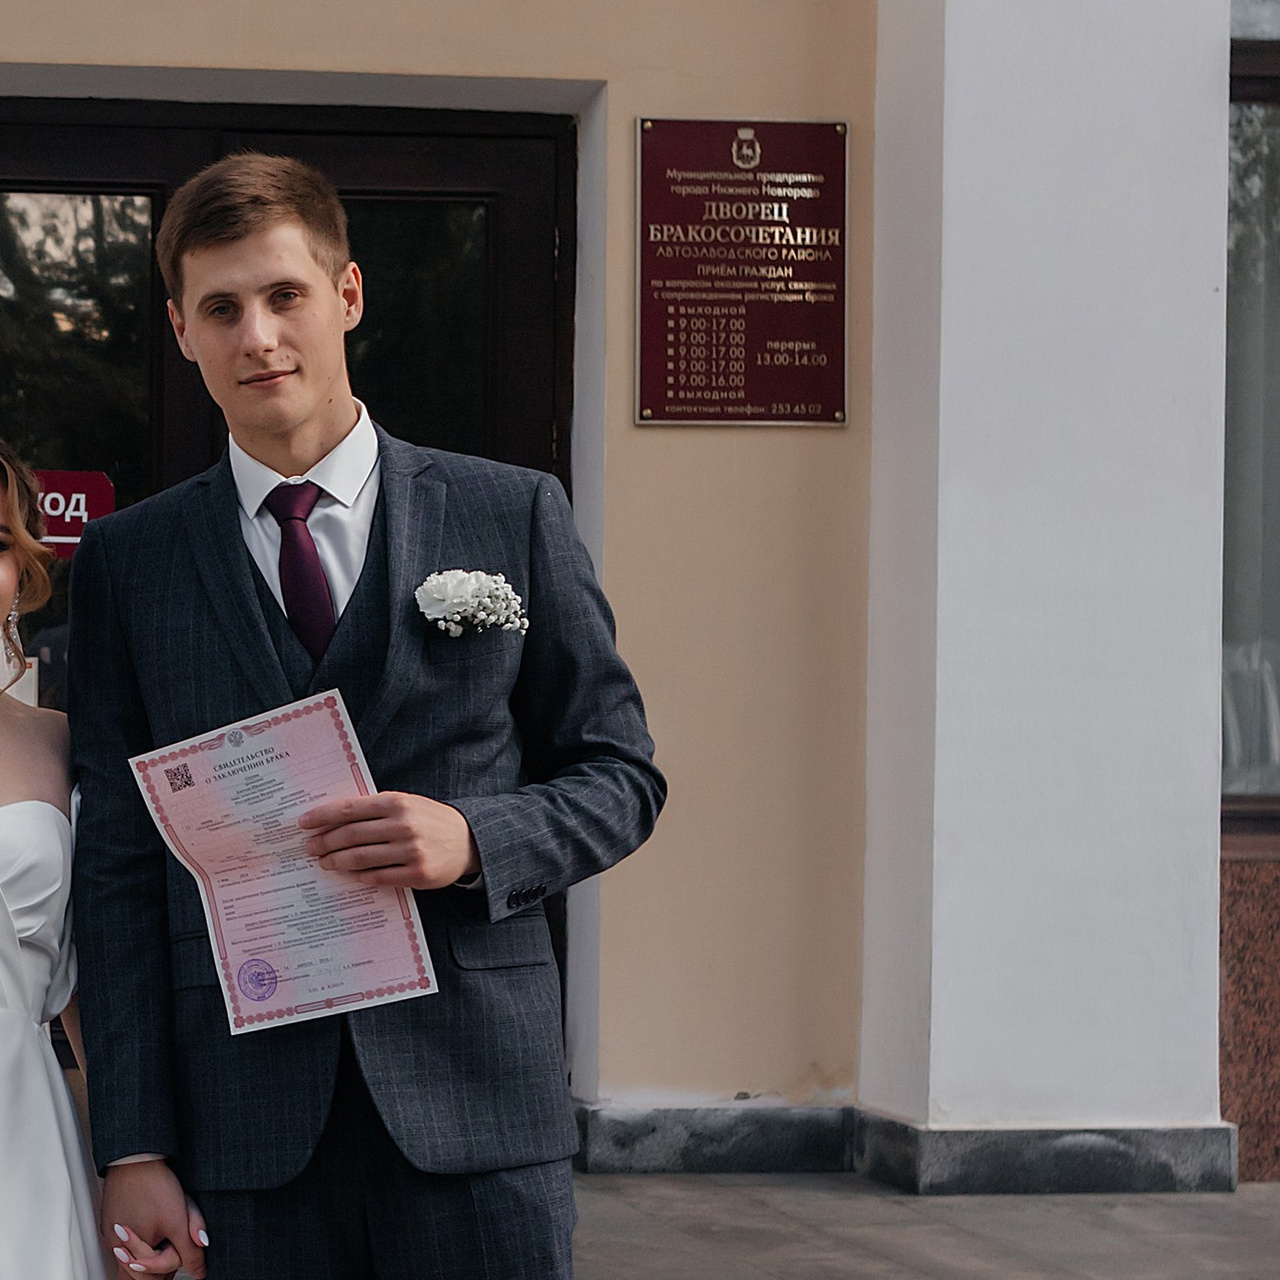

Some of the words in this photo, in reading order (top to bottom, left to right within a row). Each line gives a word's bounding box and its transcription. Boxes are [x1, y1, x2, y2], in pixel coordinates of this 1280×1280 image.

[666, 169, 754, 182] Муниципальное
[756, 172, 824, 185] предприятие
[670, 186, 709, 198] города
[712, 184, 759, 196] Нижнего
[762, 185, 820, 199] Новгорода
[702, 201, 790, 224] ДВОРЕЦ
[648, 224, 840, 246] БРАКОСОЧЕТАНИЯ
[656, 246, 778, 259] АВТОЗАВОДСКОГО
[782, 248, 832, 262] РАЙОНА
[739, 266, 792, 279] ГРАЖДАН
[679, 305, 746, 315] выходной
[767, 341, 817, 351] перерыв
[757, 353, 827, 366] 13.00-14.00
[679, 389, 745, 400] выходной
[37, 492, 88, 523] ОД
[213, 747, 275, 772] СВИДЕТЕЛЬСТВО
[213, 760, 265, 782] ЗАКЛЮЧЕНИИ
[266, 751, 290, 764] БРАКА
